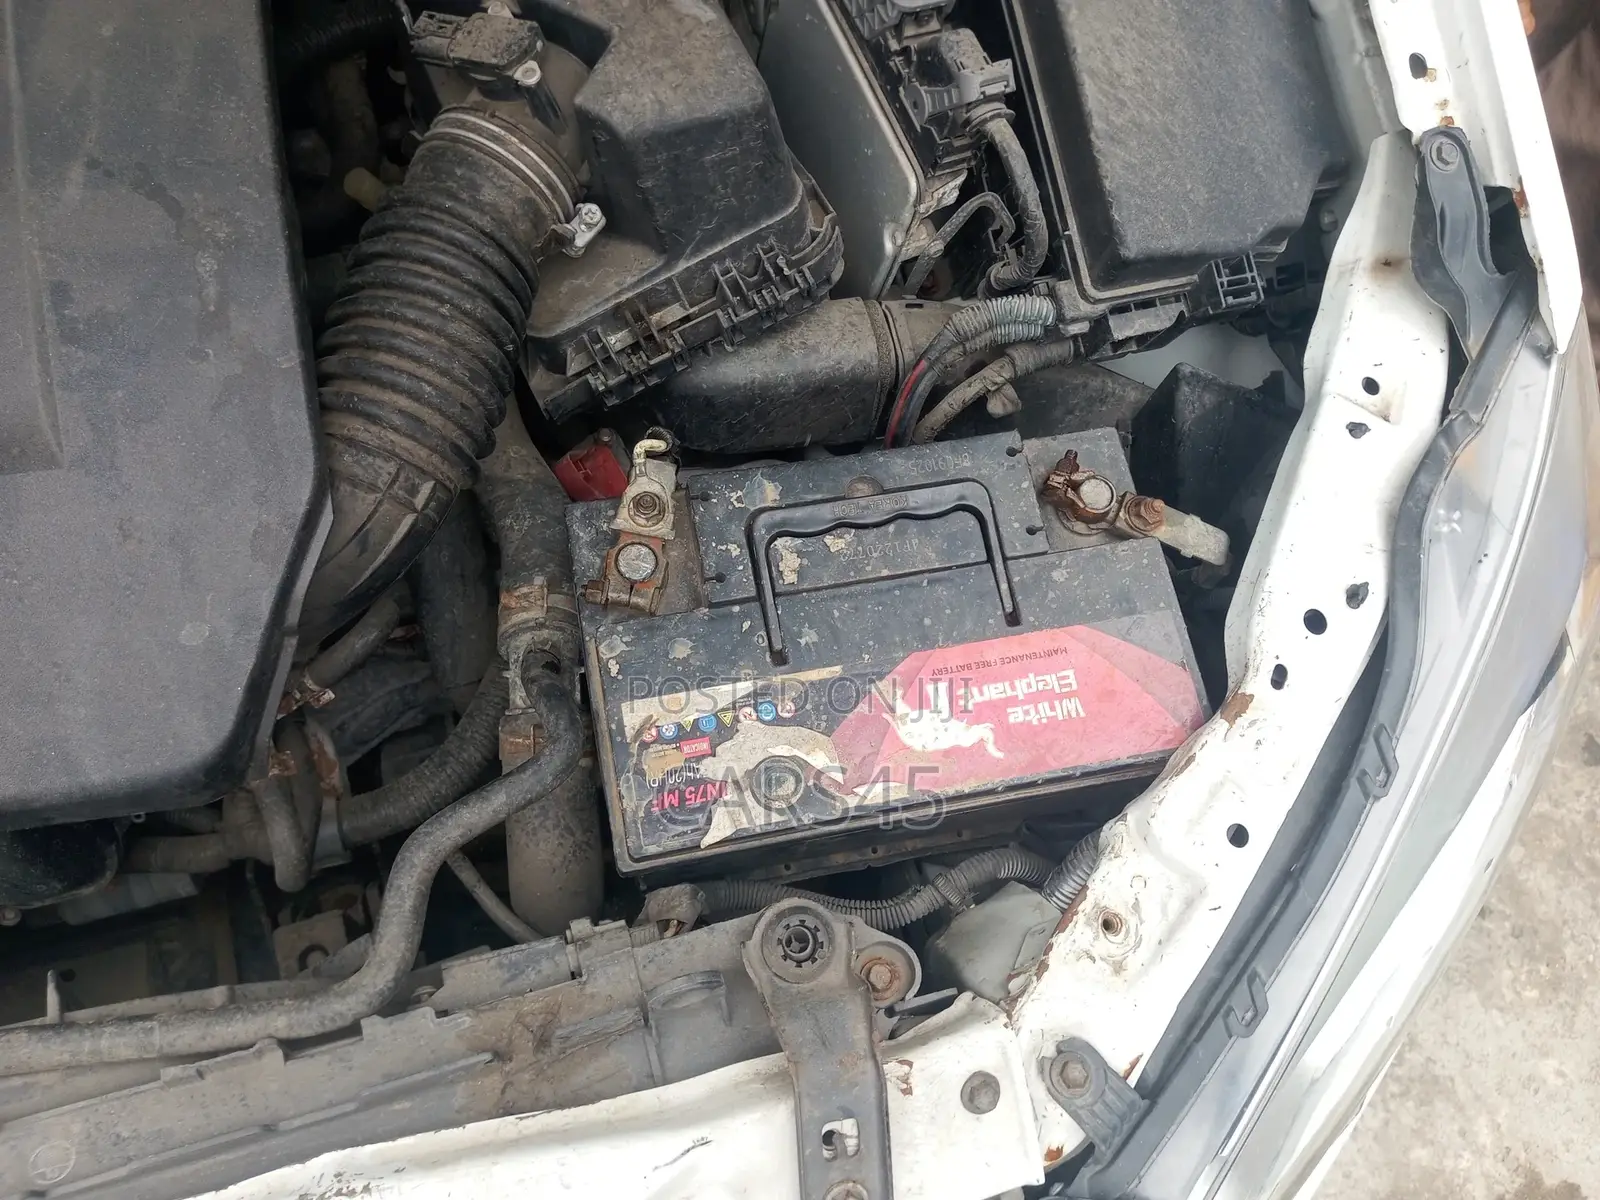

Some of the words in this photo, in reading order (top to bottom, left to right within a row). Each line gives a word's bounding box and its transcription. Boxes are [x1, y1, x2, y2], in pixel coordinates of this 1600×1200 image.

[833, 503, 862, 517] TECH
[868, 495, 909, 511] KOREA
[1000, 646, 1068, 664] MAINTENANCE
[932, 663, 973, 677] BATTERY
[976, 659, 998, 671] FREE
[956, 668, 1079, 711] Elephant
[1006, 696, 1087, 725] White
[683, 742, 709, 754] INDICATOR
[651, 789, 679, 814] MF
